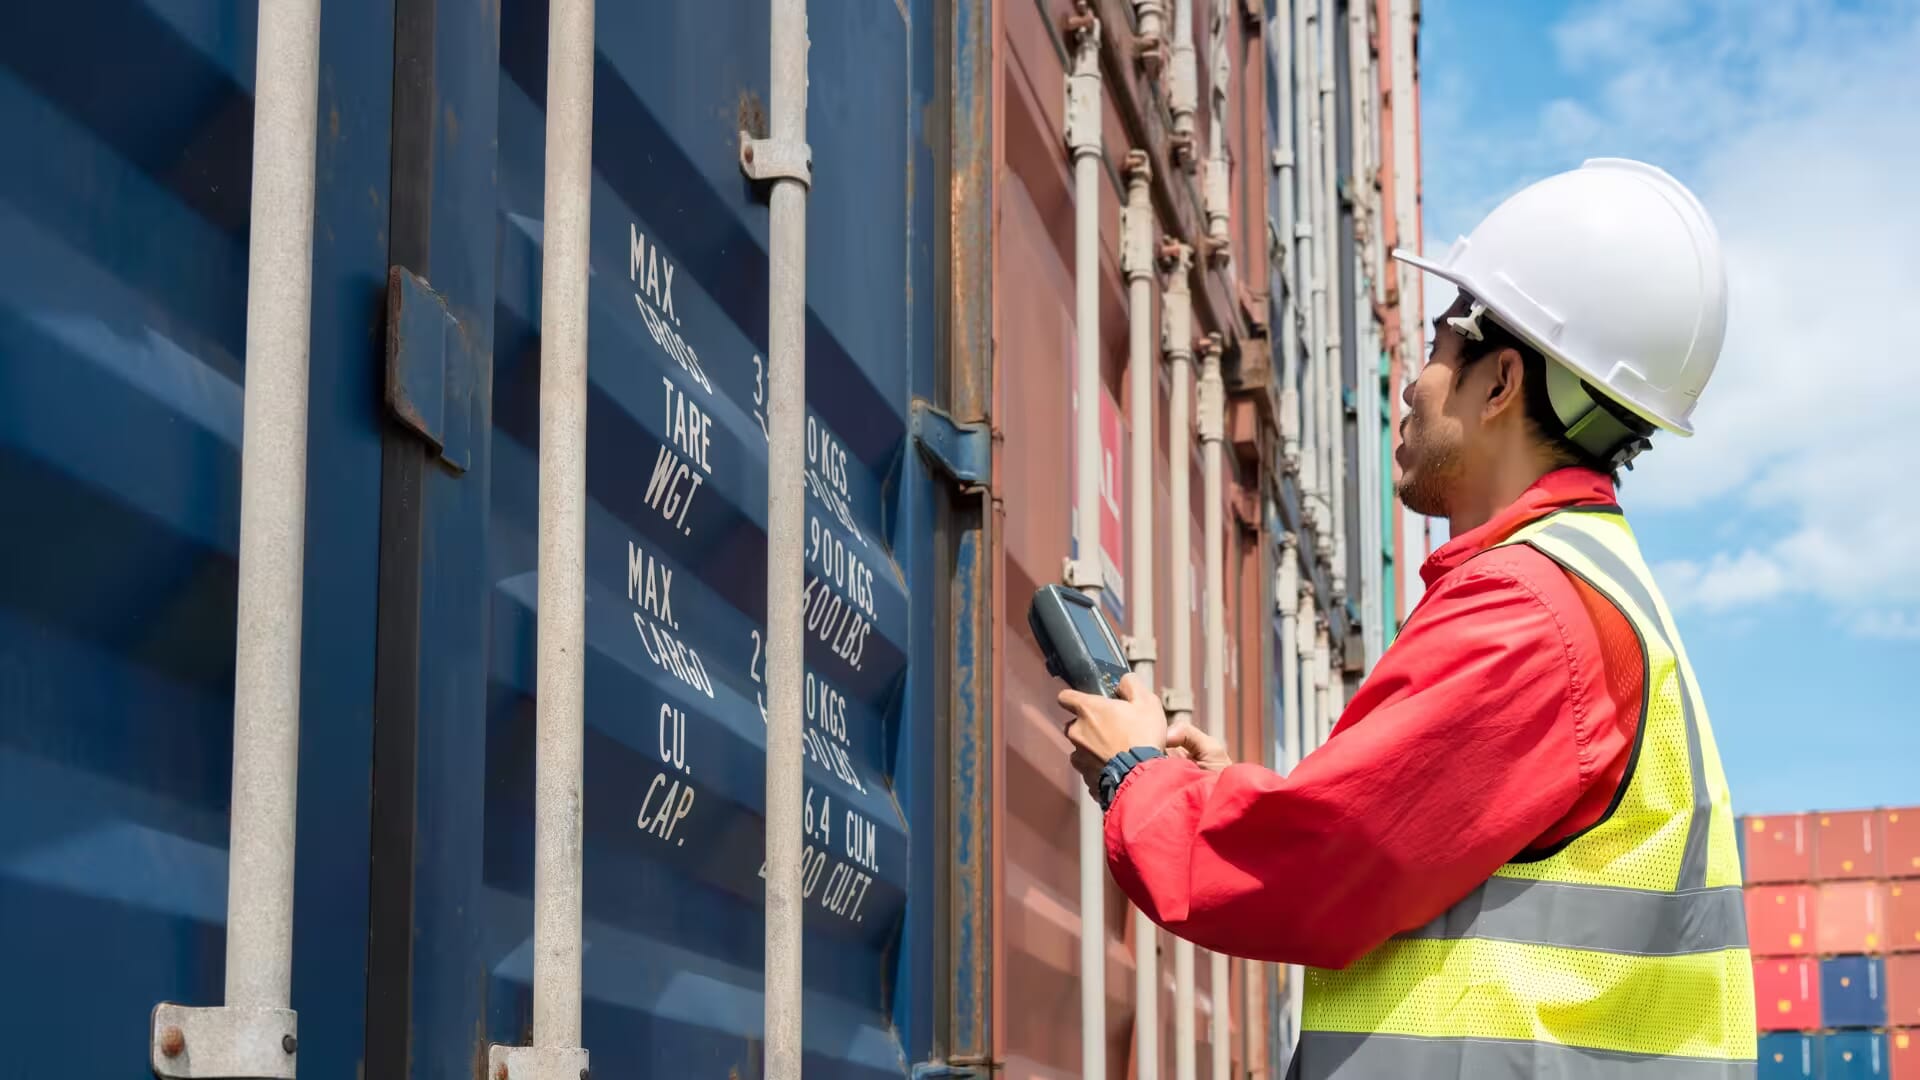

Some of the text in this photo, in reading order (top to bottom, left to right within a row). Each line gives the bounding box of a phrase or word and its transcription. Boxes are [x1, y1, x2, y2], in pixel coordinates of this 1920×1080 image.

[630, 222, 681, 327] MAX.
[634, 292, 713, 395] GROSS
[662, 375, 712, 475] TARE
[821, 428, 852, 502] KGS.
[643, 444, 704, 537] WGT.
[628, 540, 679, 632] MAX.
[847, 550, 878, 622] KGS.
[633, 611, 714, 699] CARGO
[659, 702, 691, 775] CU.
[820, 680, 851, 747] KGS.
[637, 772, 695, 847] CAP.
[845, 809, 879, 873] CU.M.
